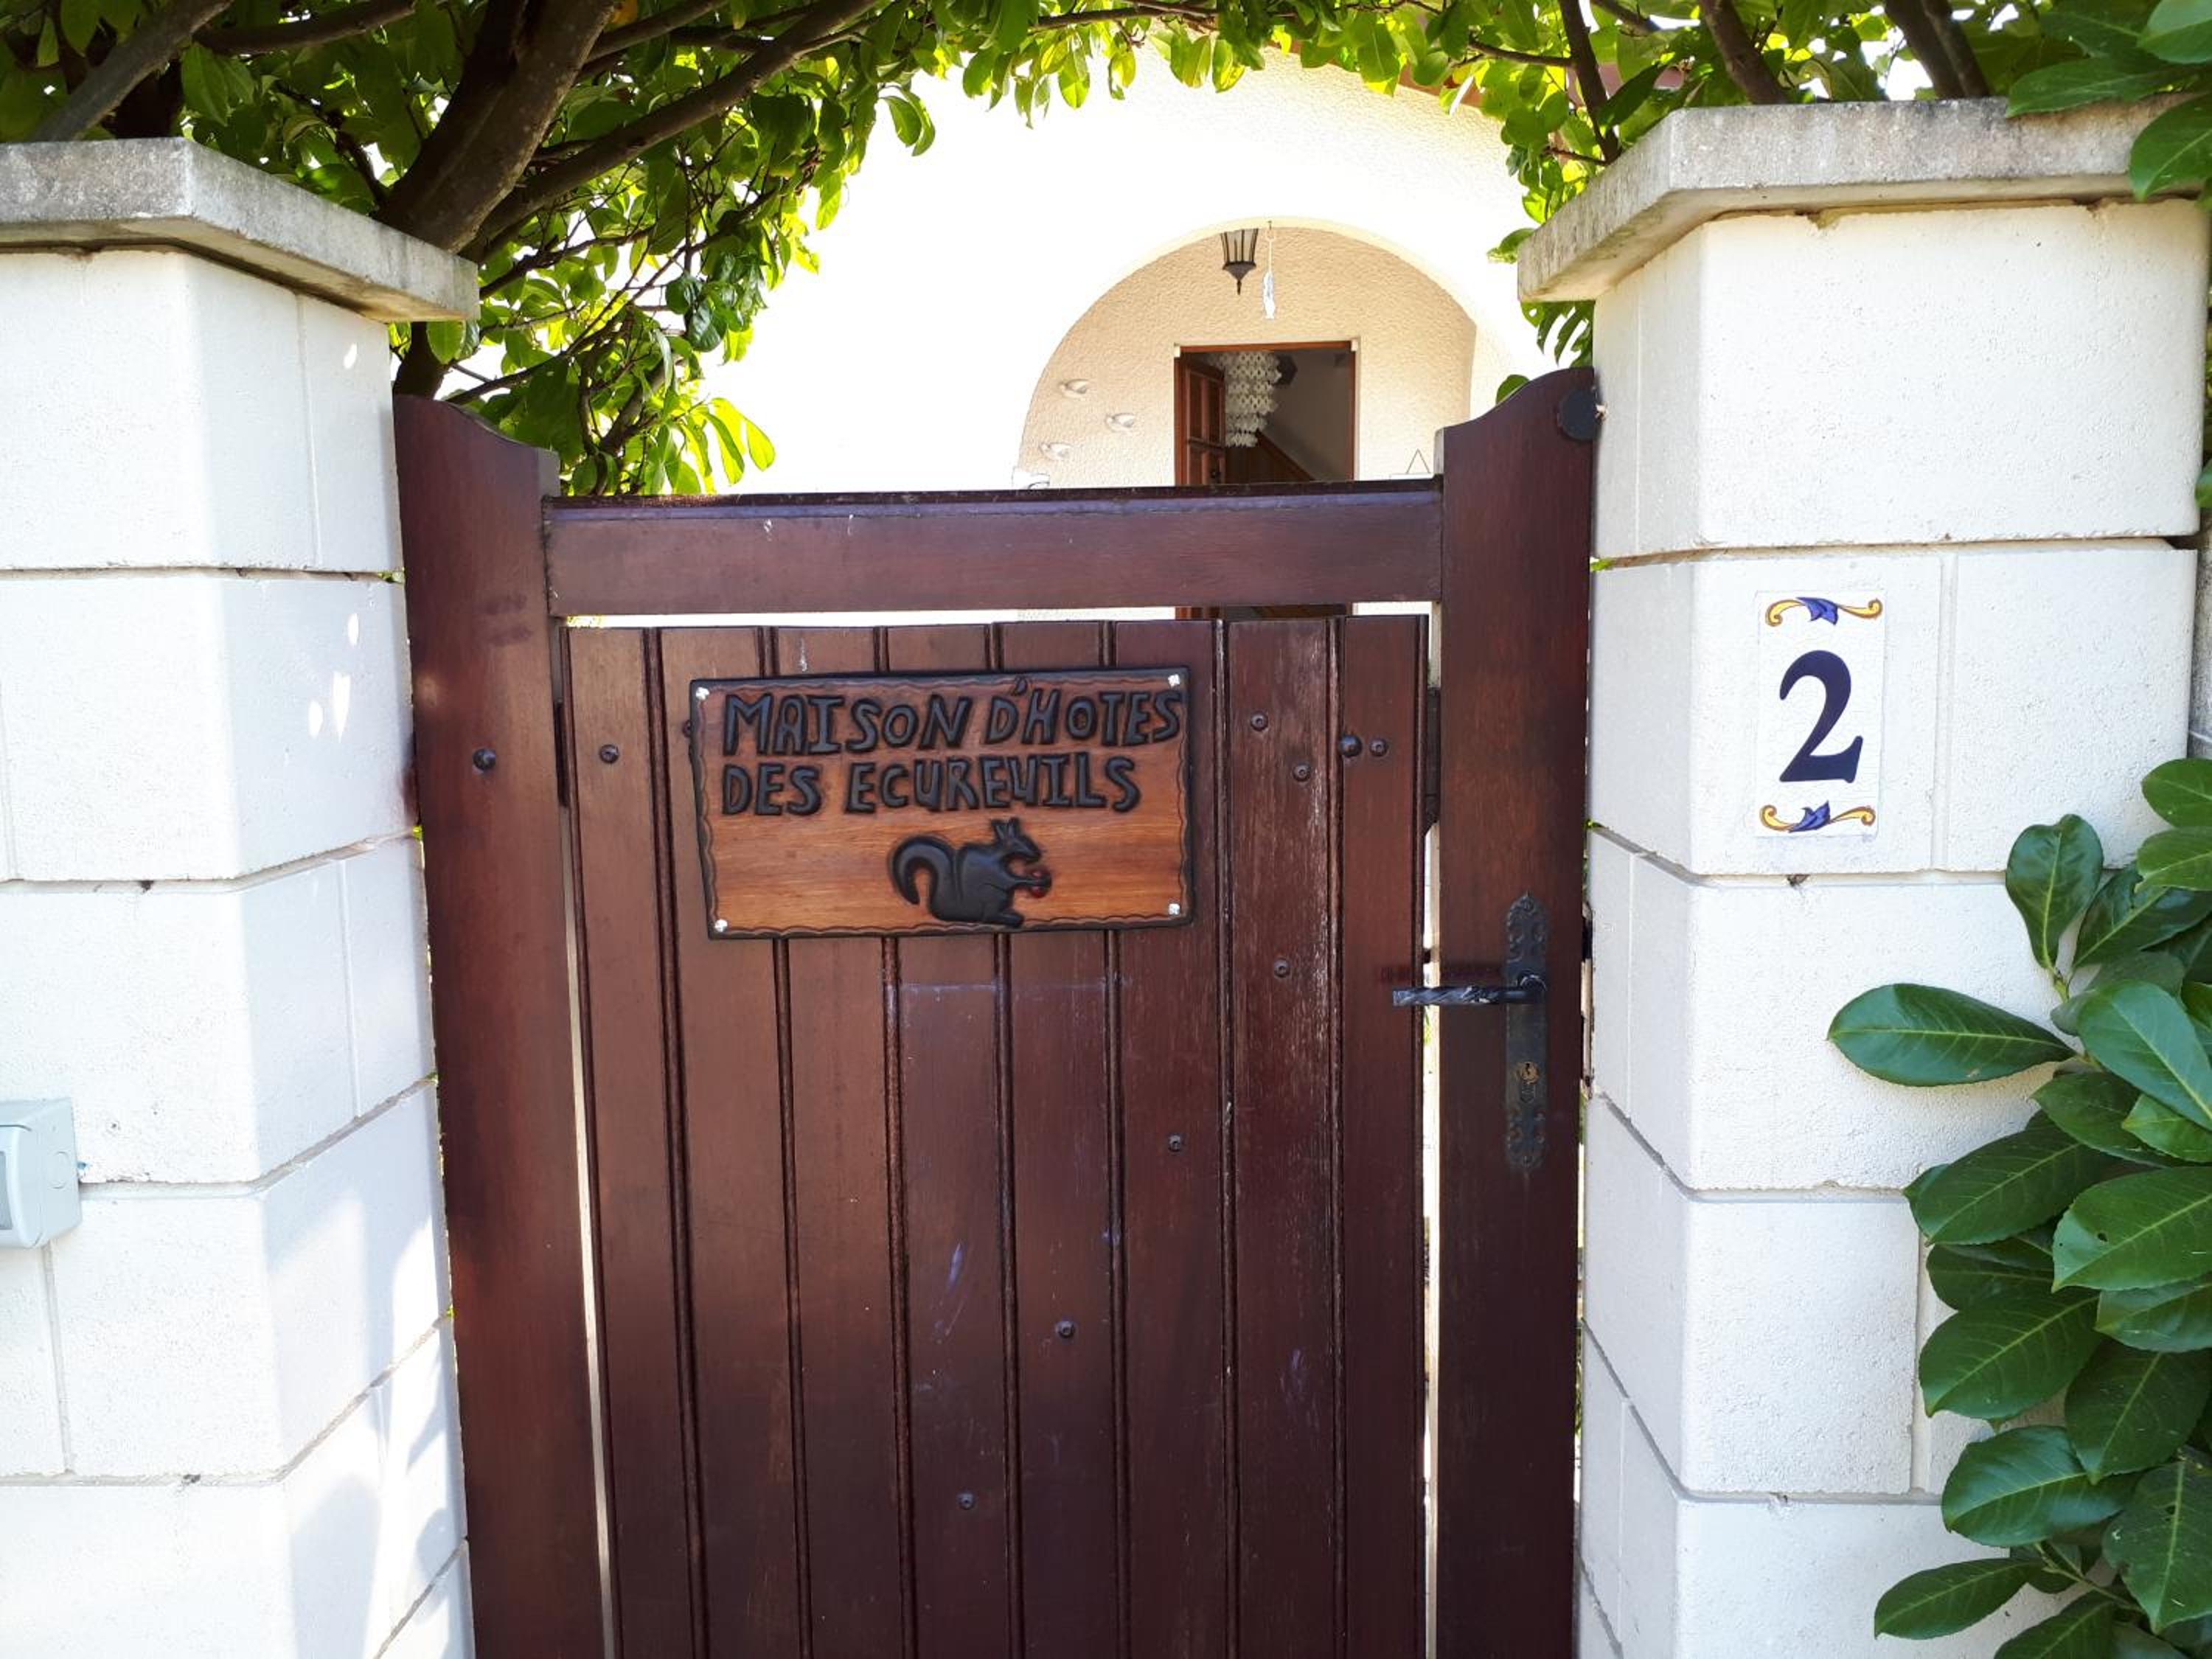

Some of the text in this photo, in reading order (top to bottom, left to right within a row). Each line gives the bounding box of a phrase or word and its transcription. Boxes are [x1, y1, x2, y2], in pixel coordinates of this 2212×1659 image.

[723, 678, 1183, 756] MAISON D'HOTES
[1779, 650, 1864, 784] 2
[722, 752, 1141, 815] DES ECUREUILS
